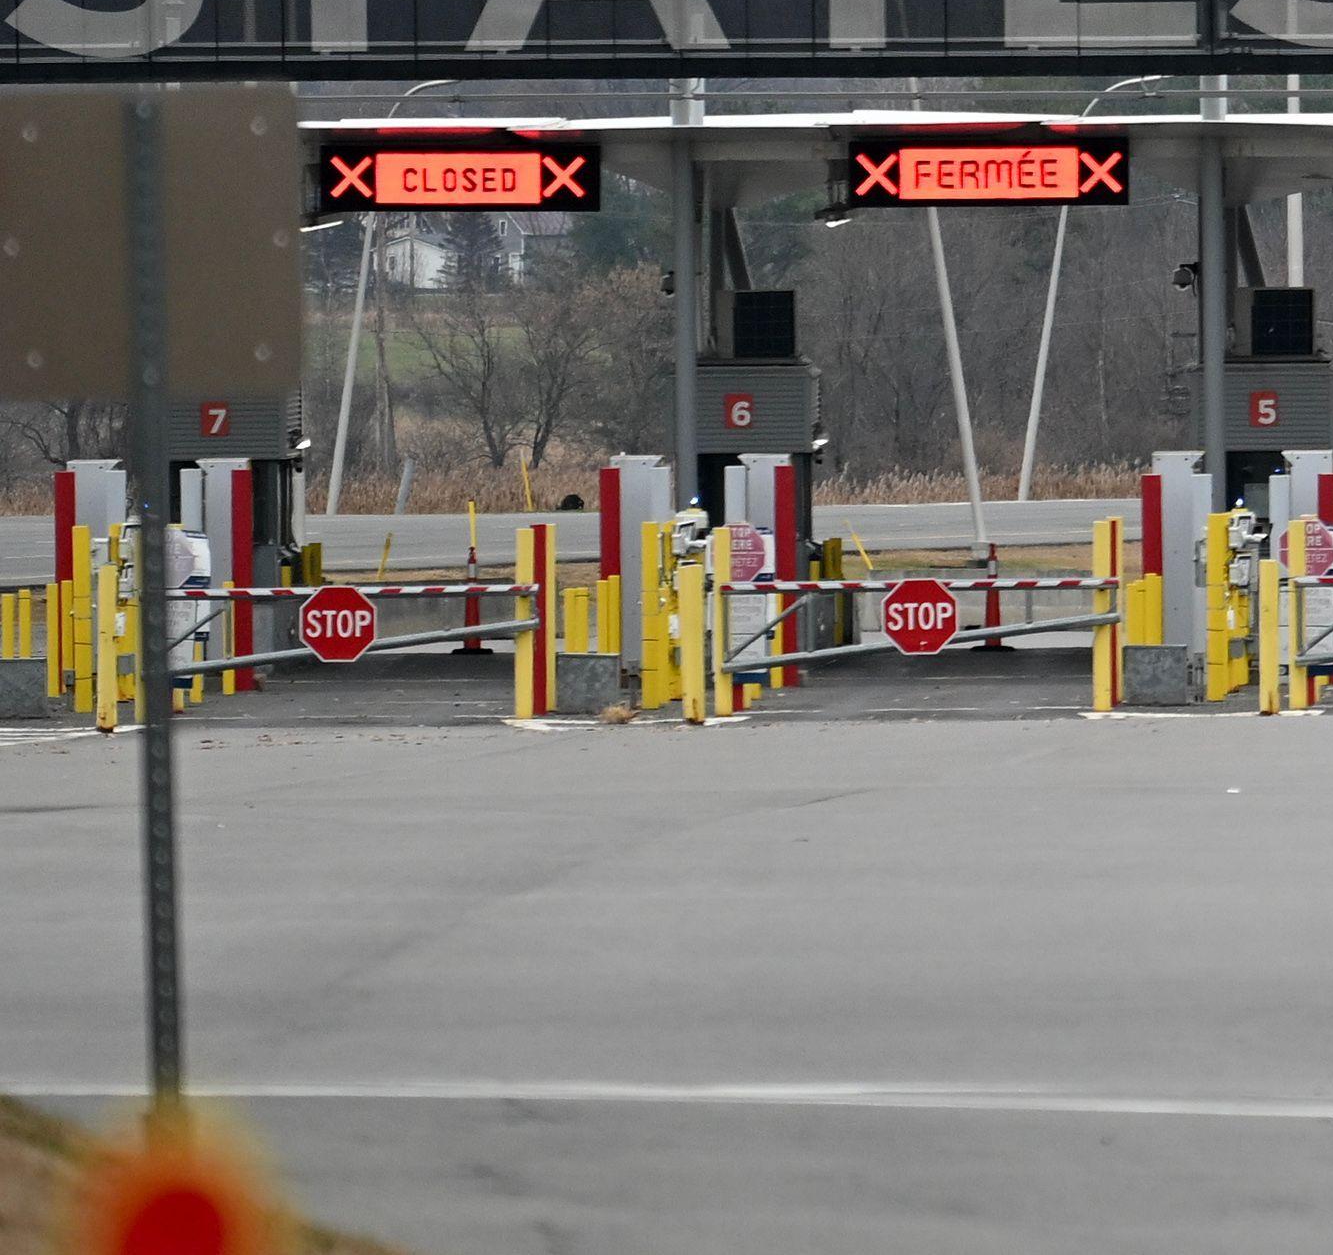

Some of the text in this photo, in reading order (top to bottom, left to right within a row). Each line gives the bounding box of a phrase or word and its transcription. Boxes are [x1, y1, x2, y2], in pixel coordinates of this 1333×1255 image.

[403, 167, 517, 193] CLOSED
[914, 151, 1058, 190] FERMÉE
[208, 409, 227, 435] 7
[731, 401, 752, 427] 6
[1257, 398, 1277, 424] 5
[306, 609, 372, 637] STOP
[887, 602, 955, 631] STOP
